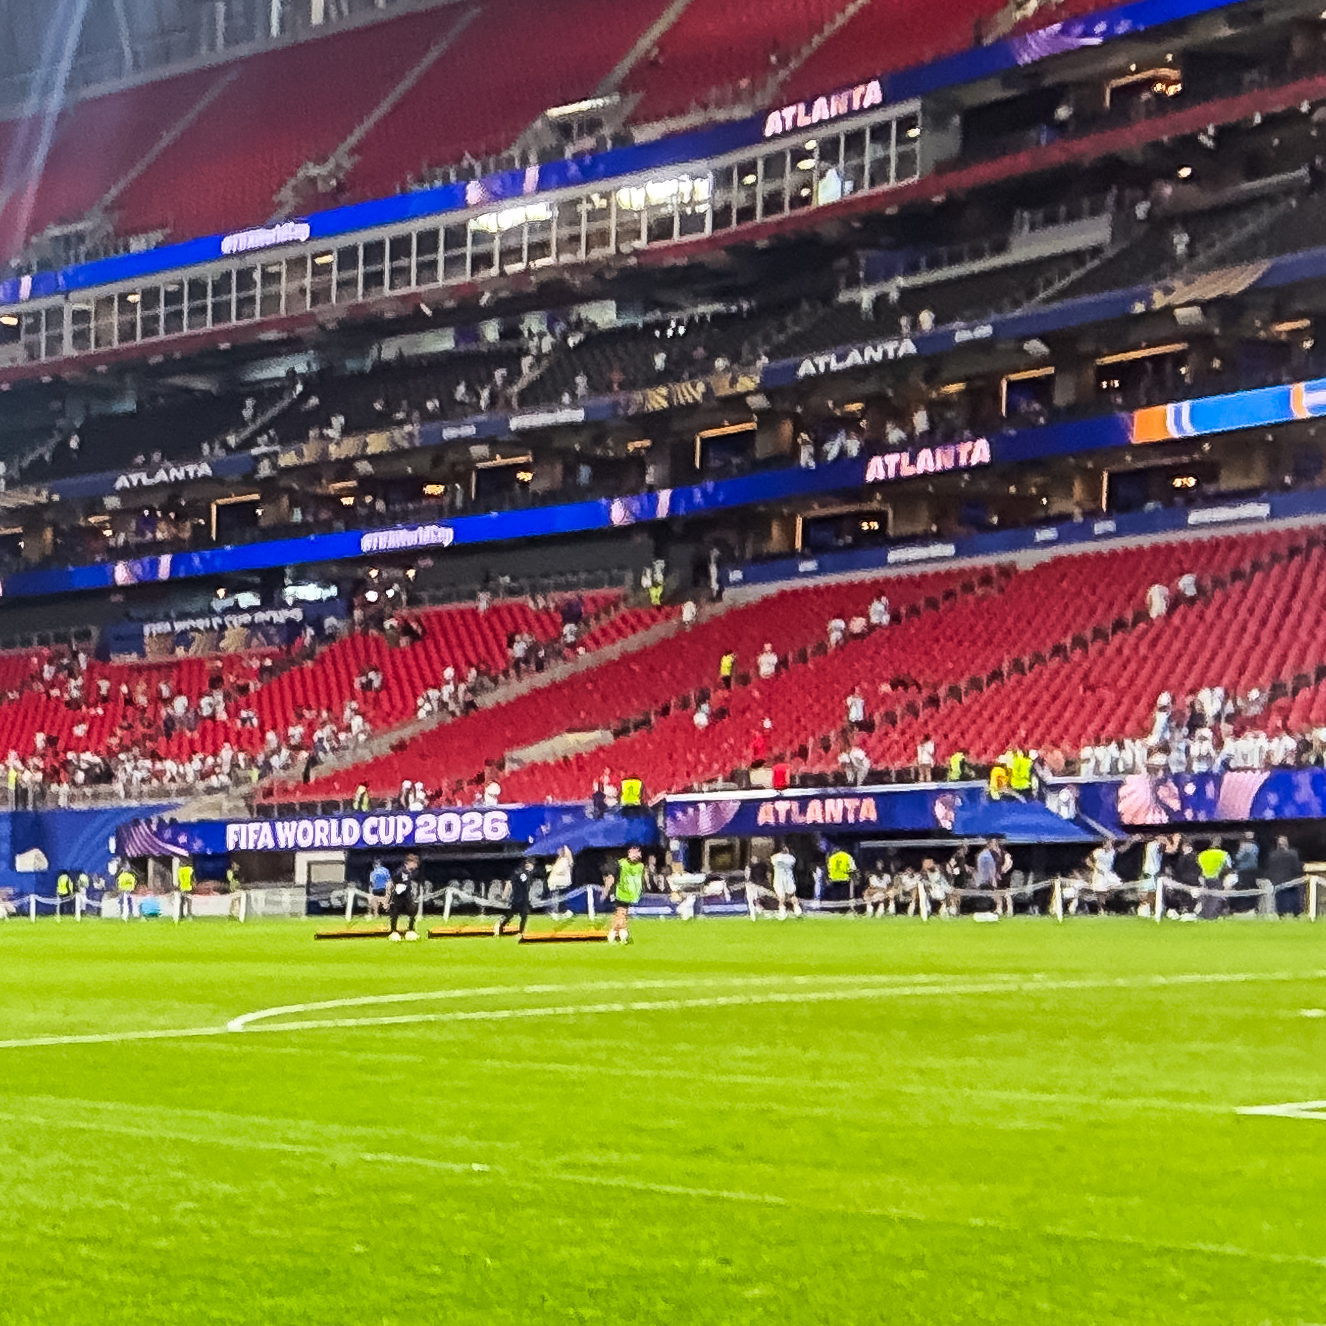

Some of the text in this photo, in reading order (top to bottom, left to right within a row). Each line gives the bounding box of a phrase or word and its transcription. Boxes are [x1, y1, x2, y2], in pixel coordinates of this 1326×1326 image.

[763, 79, 883, 138] ATLANTA
[796, 338, 918, 379] ATLANTA
[114, 462, 213, 490] ATLANTA
[865, 437, 992, 483] ATLANTA
[226, 810, 511, 851] FIFA WORLD CUP 2026
[756, 796, 878, 827] ATLANTA
